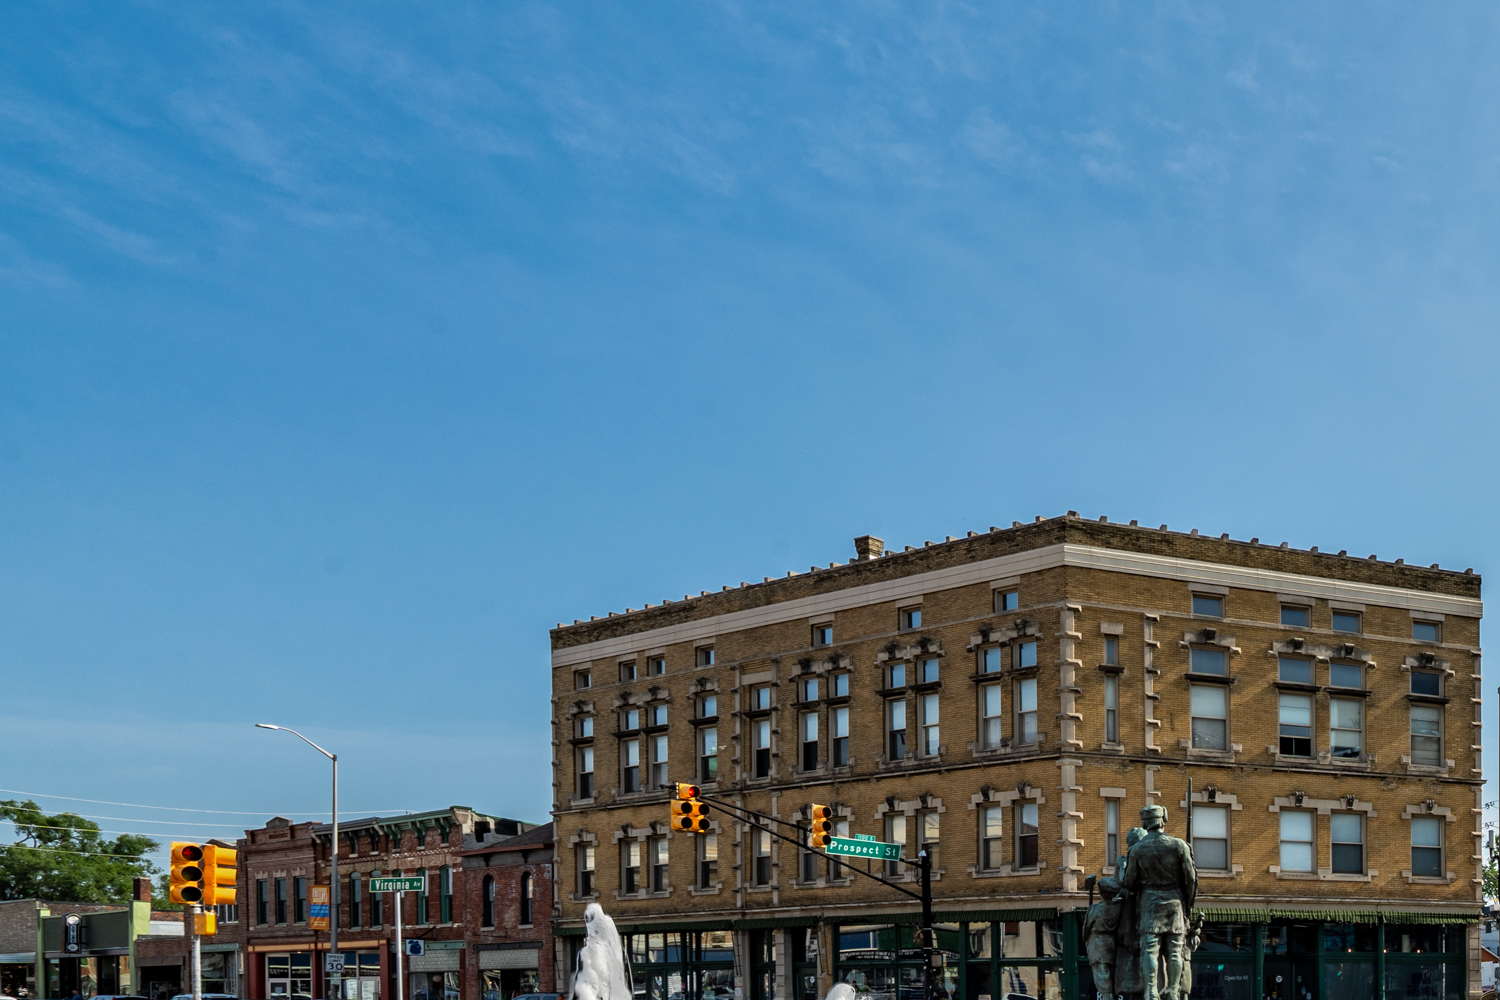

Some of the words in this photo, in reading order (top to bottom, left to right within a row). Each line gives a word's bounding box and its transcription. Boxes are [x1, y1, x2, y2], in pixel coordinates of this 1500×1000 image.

[830, 841, 879, 855] Prospect
[885, 847, 896, 856] St
[375, 880, 410, 891] Virginia
[328, 963, 343, 971] 30
